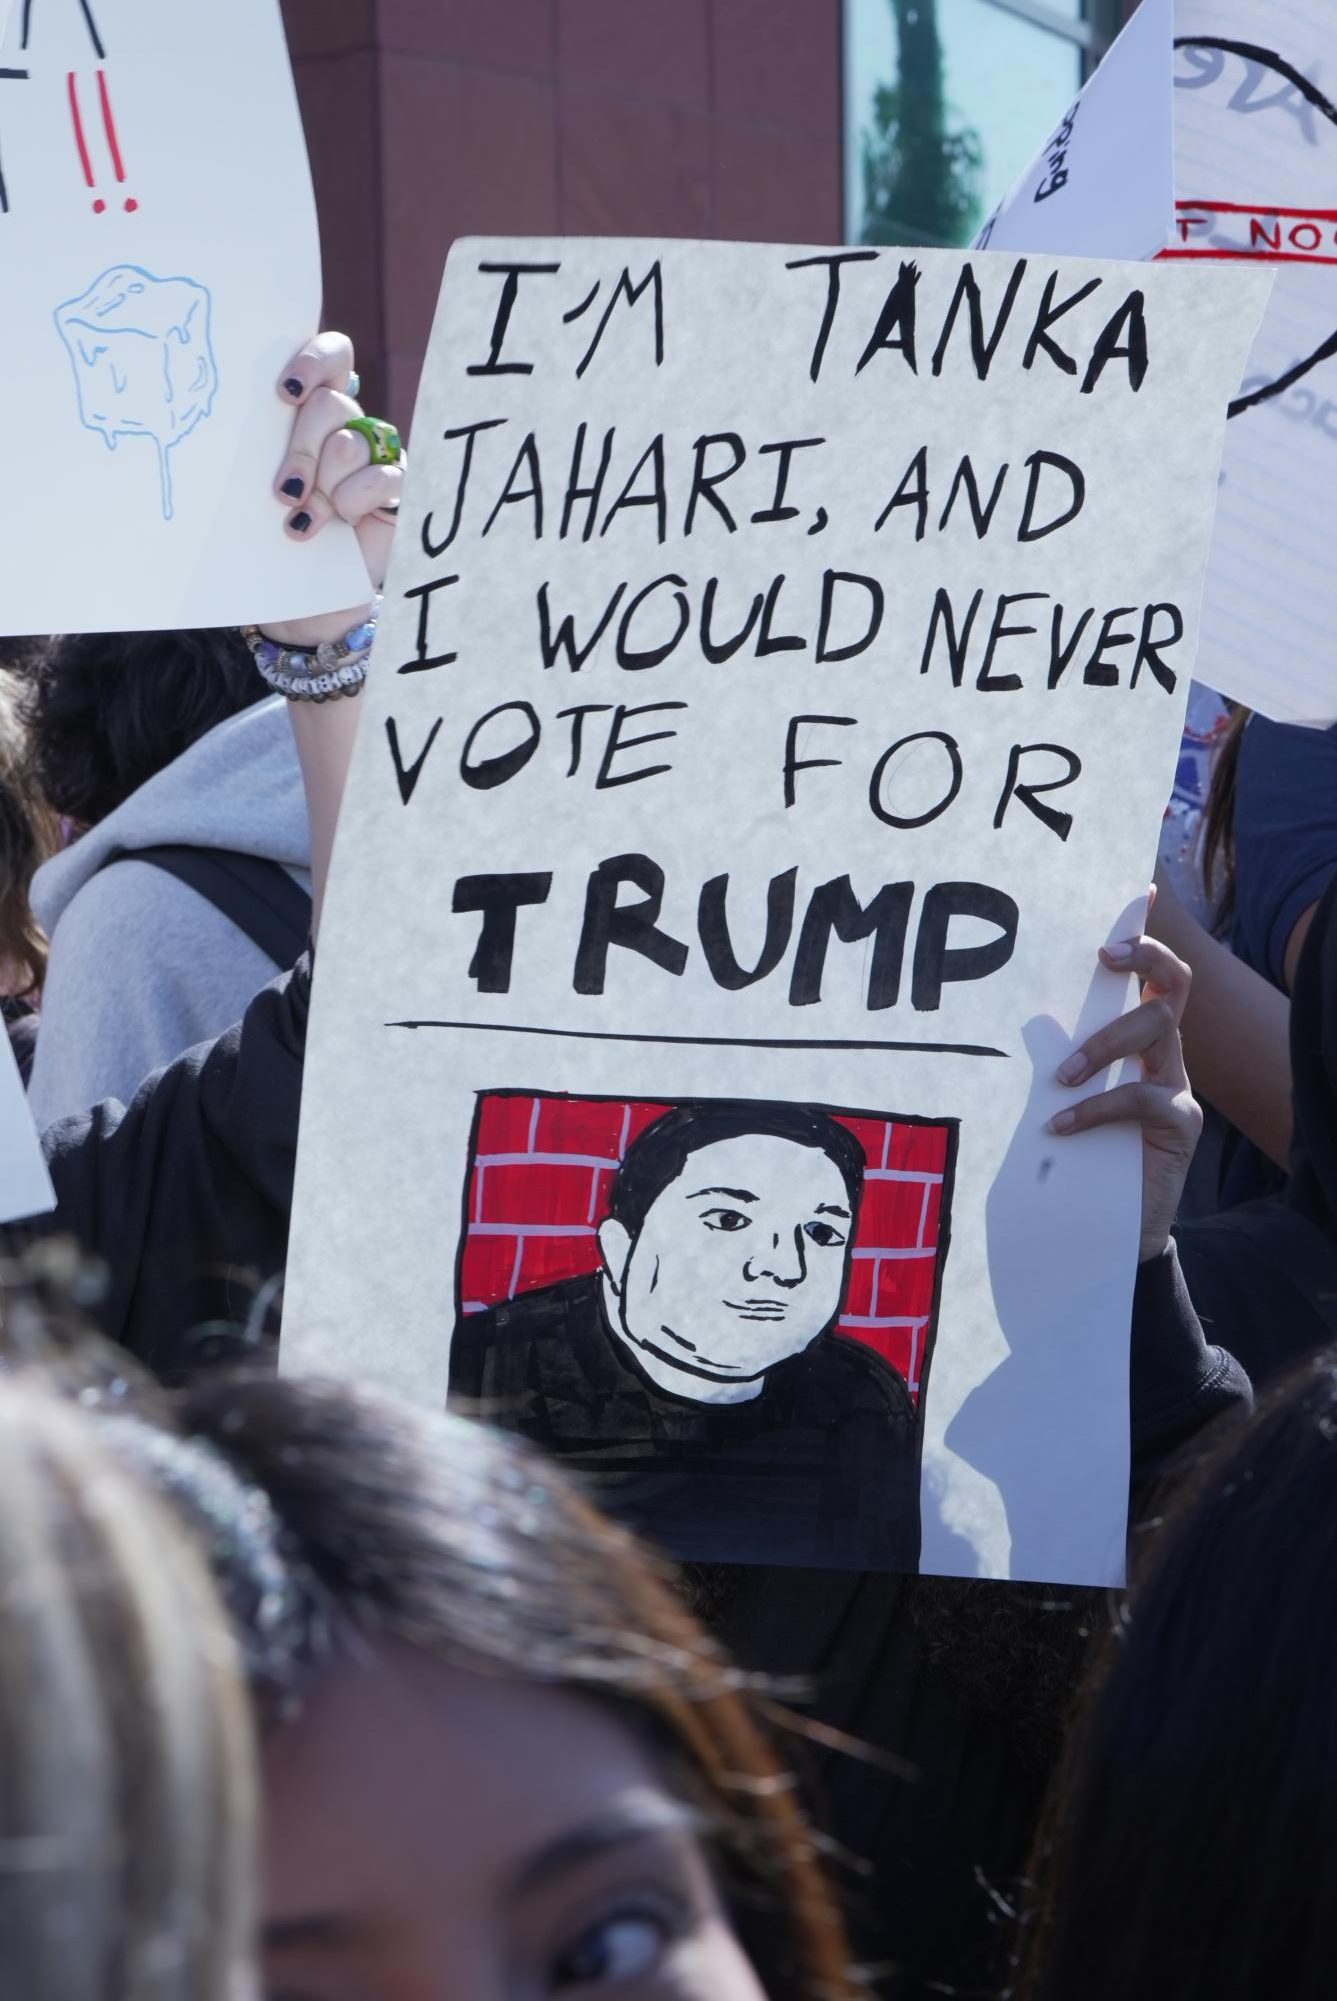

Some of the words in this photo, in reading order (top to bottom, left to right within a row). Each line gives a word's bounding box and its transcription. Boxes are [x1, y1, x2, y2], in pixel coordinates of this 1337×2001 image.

[1250, 217, 1337, 251] NO
[467, 261, 663, 378] I'M
[786, 251, 1148, 393] TANKA
[422, 419, 828, 558] JAHARI,
[875, 446, 1084, 542] AND
[398, 575, 459, 674] I
[537, 569, 884, 672] WOULD
[921, 588, 1183, 694] NEVER
[386, 701, 688, 805] VOTE
[783, 715, 1081, 841] FOR
[452, 854, 1019, 1011] TRUMP
